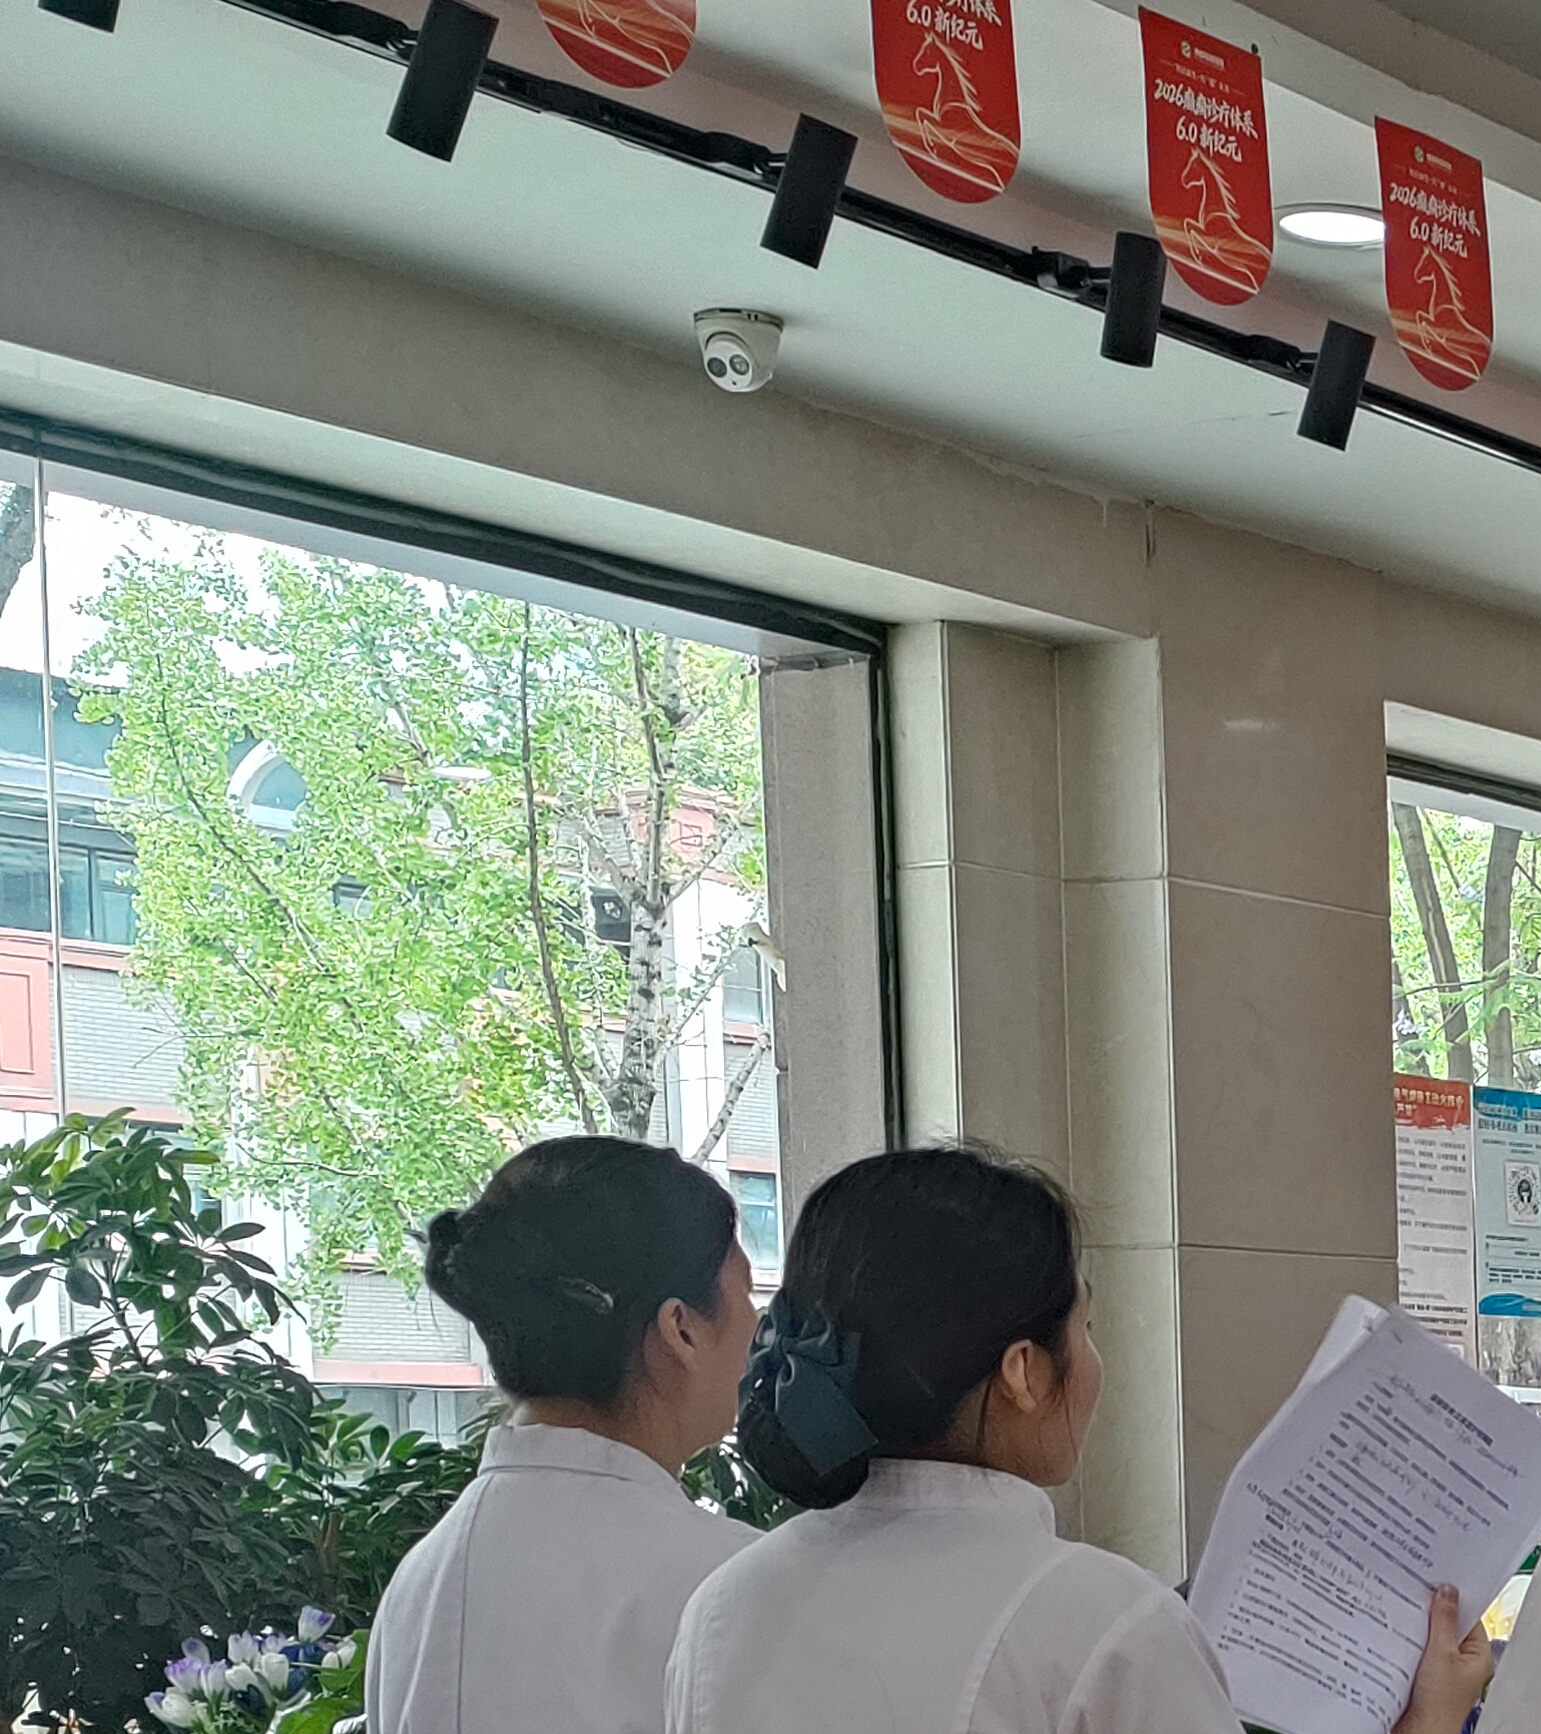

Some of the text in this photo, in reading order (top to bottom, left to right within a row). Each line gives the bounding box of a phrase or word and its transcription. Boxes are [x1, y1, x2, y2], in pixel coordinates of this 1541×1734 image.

[906, 0, 931, 27] 6.0
[1176, 116, 1197, 142] 6.0
[1408, 220, 1430, 241] 6.0
